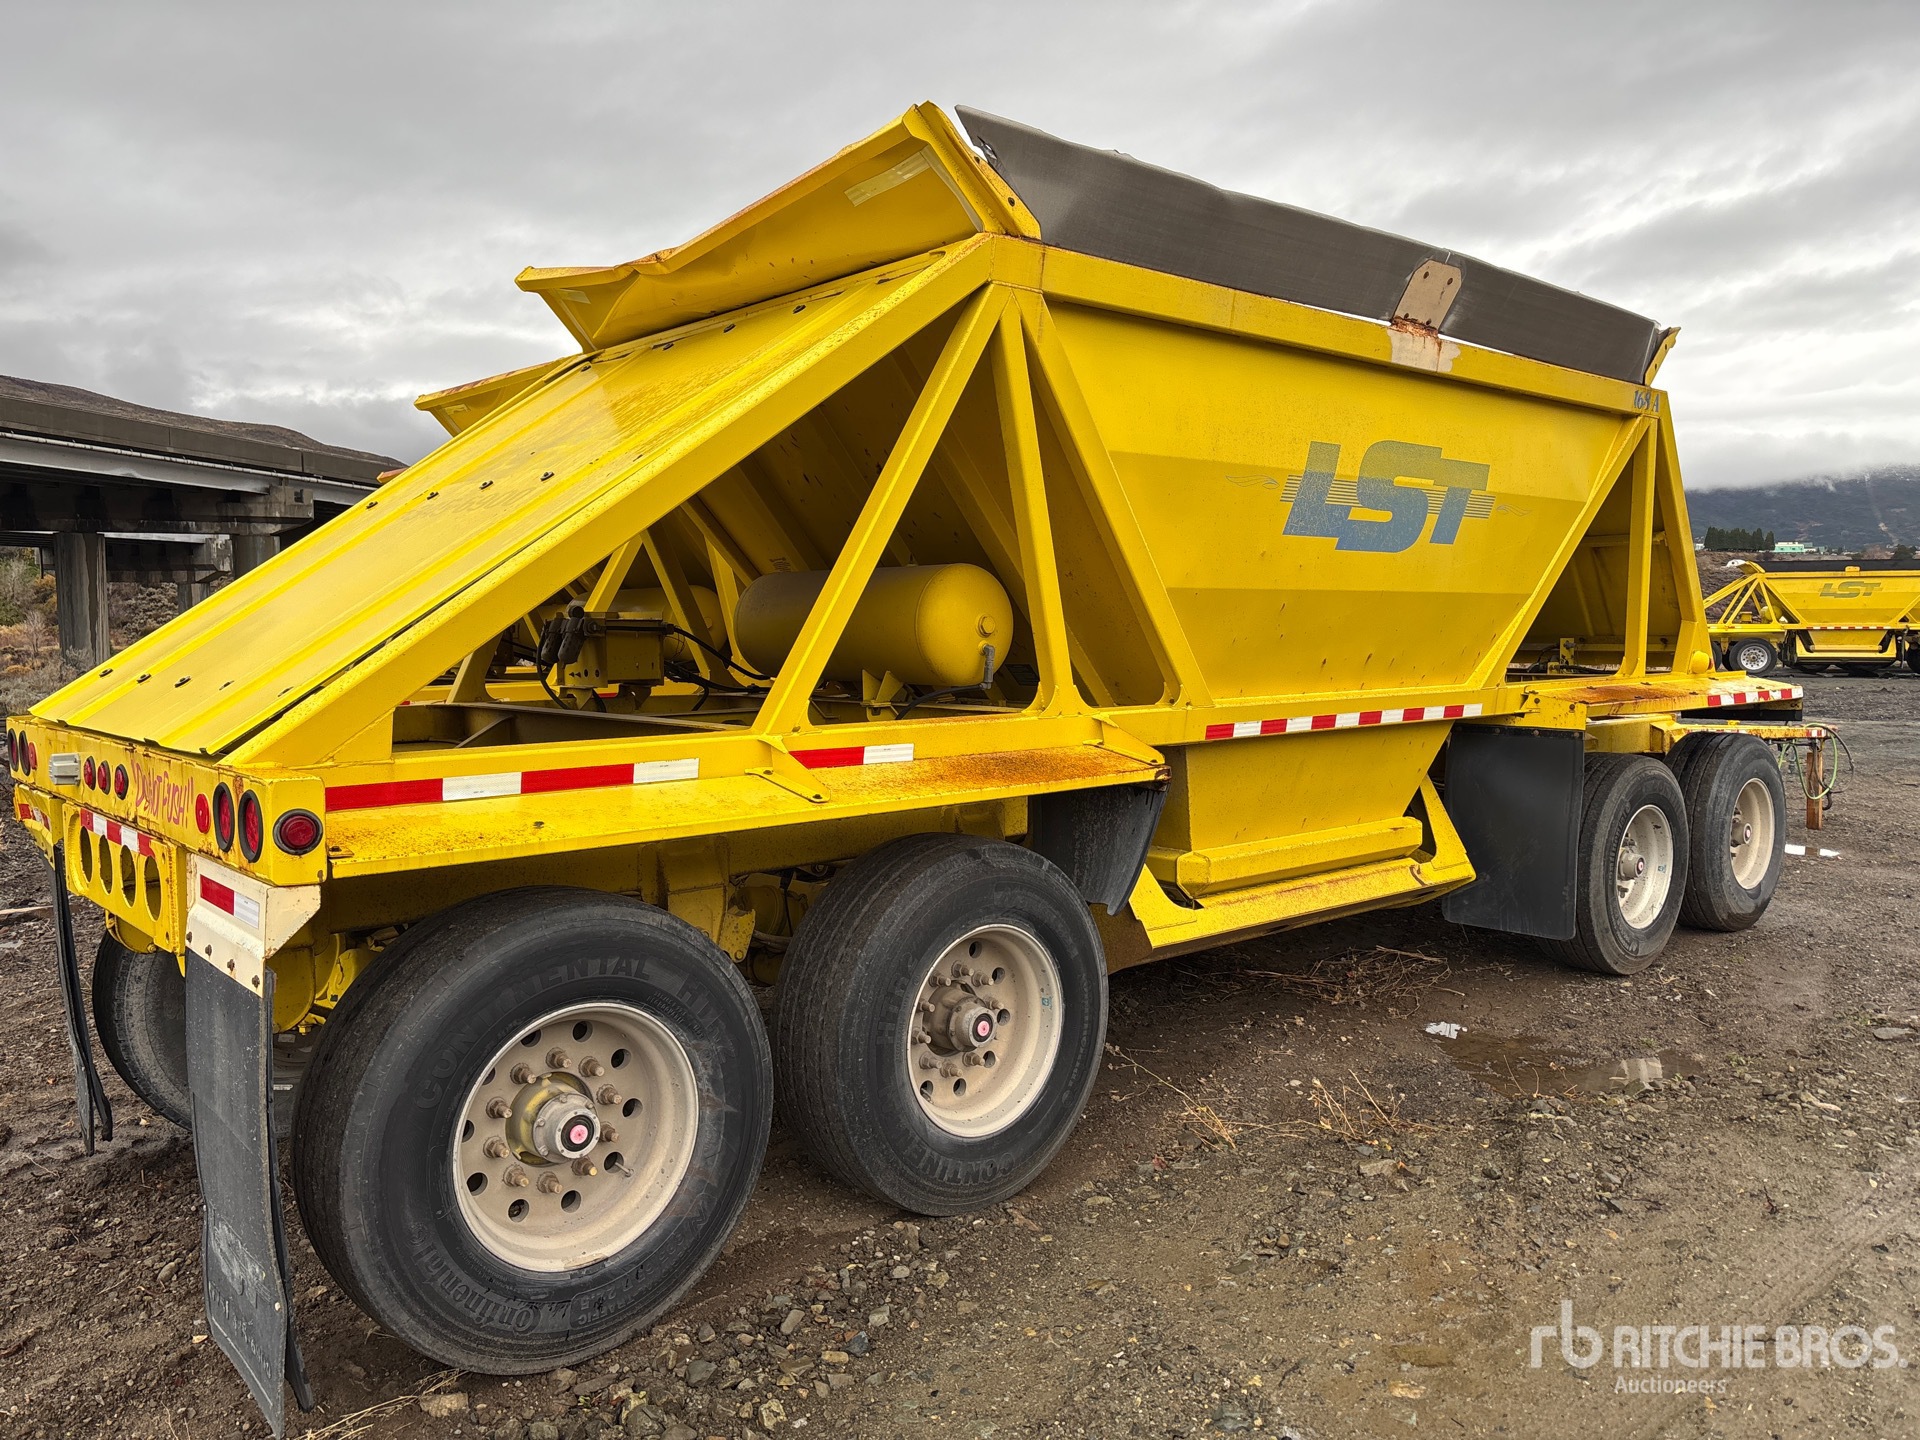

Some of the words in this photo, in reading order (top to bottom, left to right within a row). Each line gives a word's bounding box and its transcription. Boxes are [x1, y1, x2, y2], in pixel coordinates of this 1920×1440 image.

[1282, 439, 1491, 553] LST
[1819, 581, 1882, 599] LST
[411, 1242, 541, 1336] Continental
[578, 1293, 635, 1325] TRAFFIC
